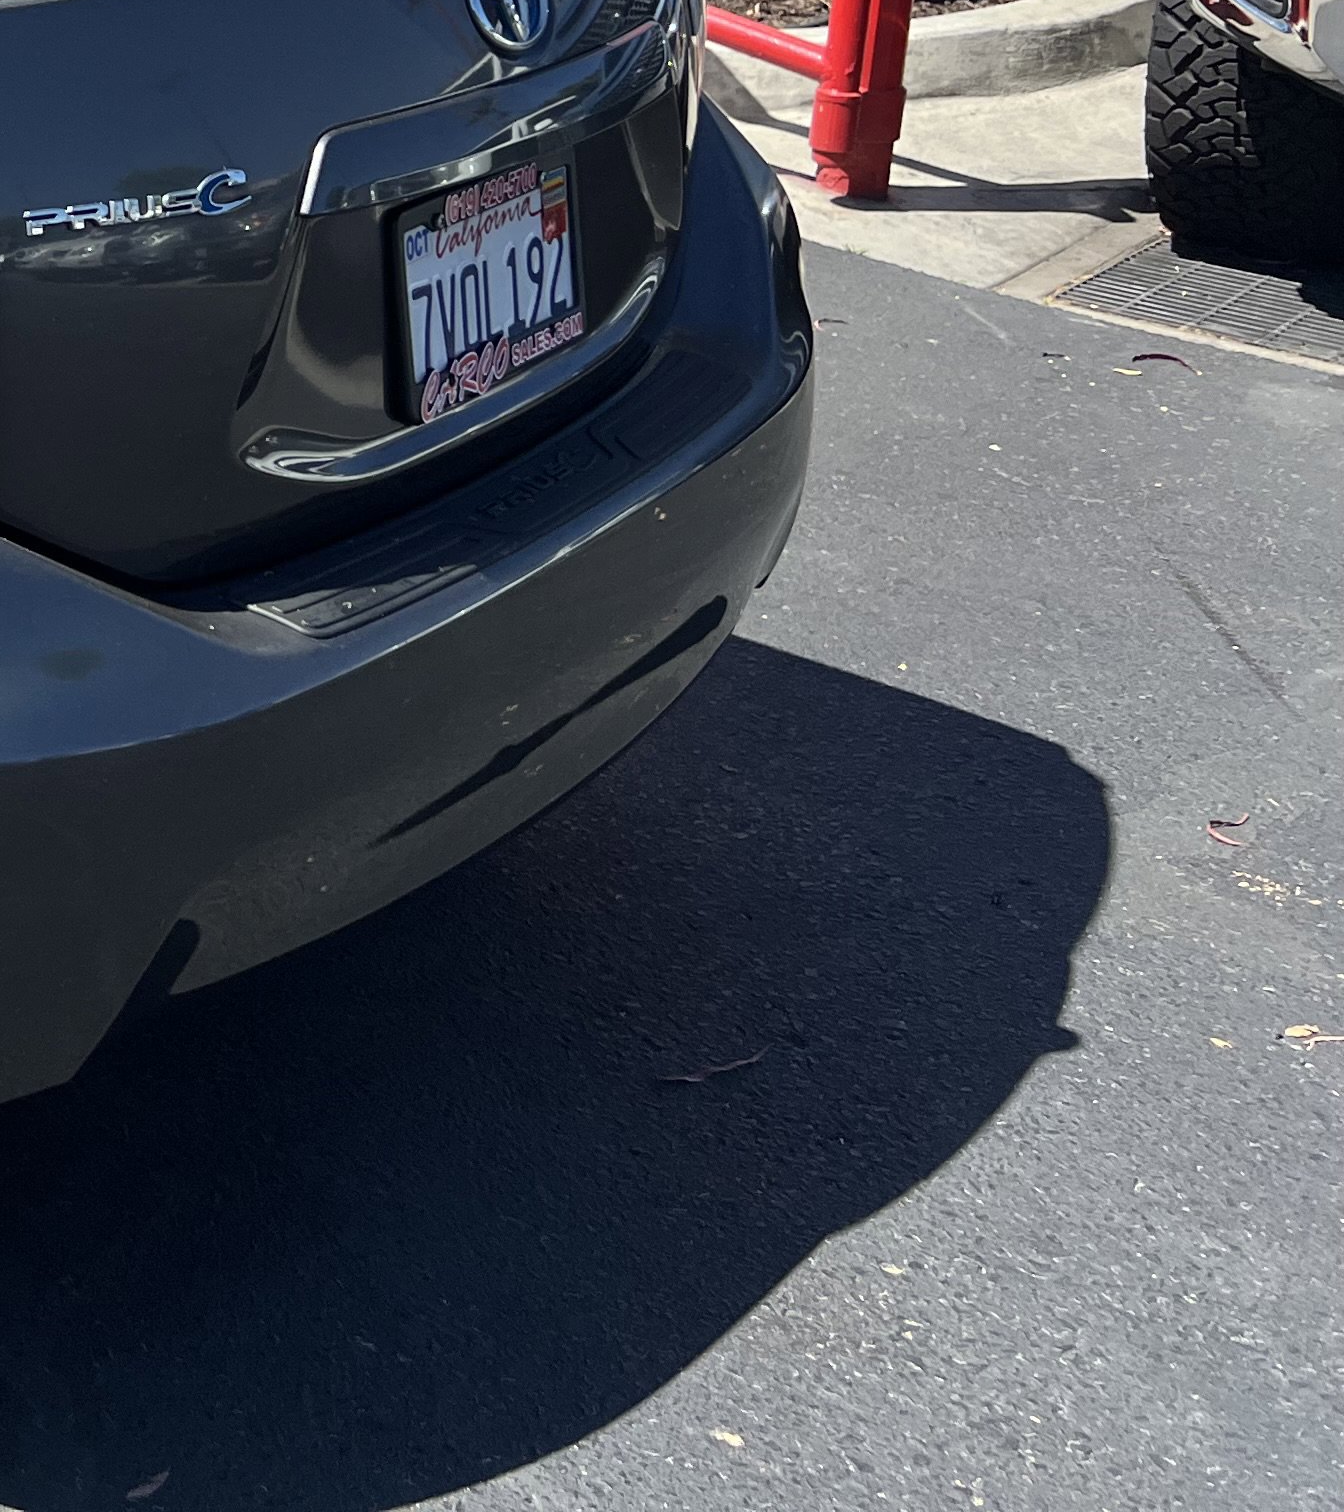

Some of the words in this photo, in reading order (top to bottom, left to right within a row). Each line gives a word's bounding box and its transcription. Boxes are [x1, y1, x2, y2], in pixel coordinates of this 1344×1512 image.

[435, 194, 544, 259] California
[444, 187, 481, 226] (619)
[407, 228, 430, 261] OCT
[511, 312, 584, 367] SALES.COM
